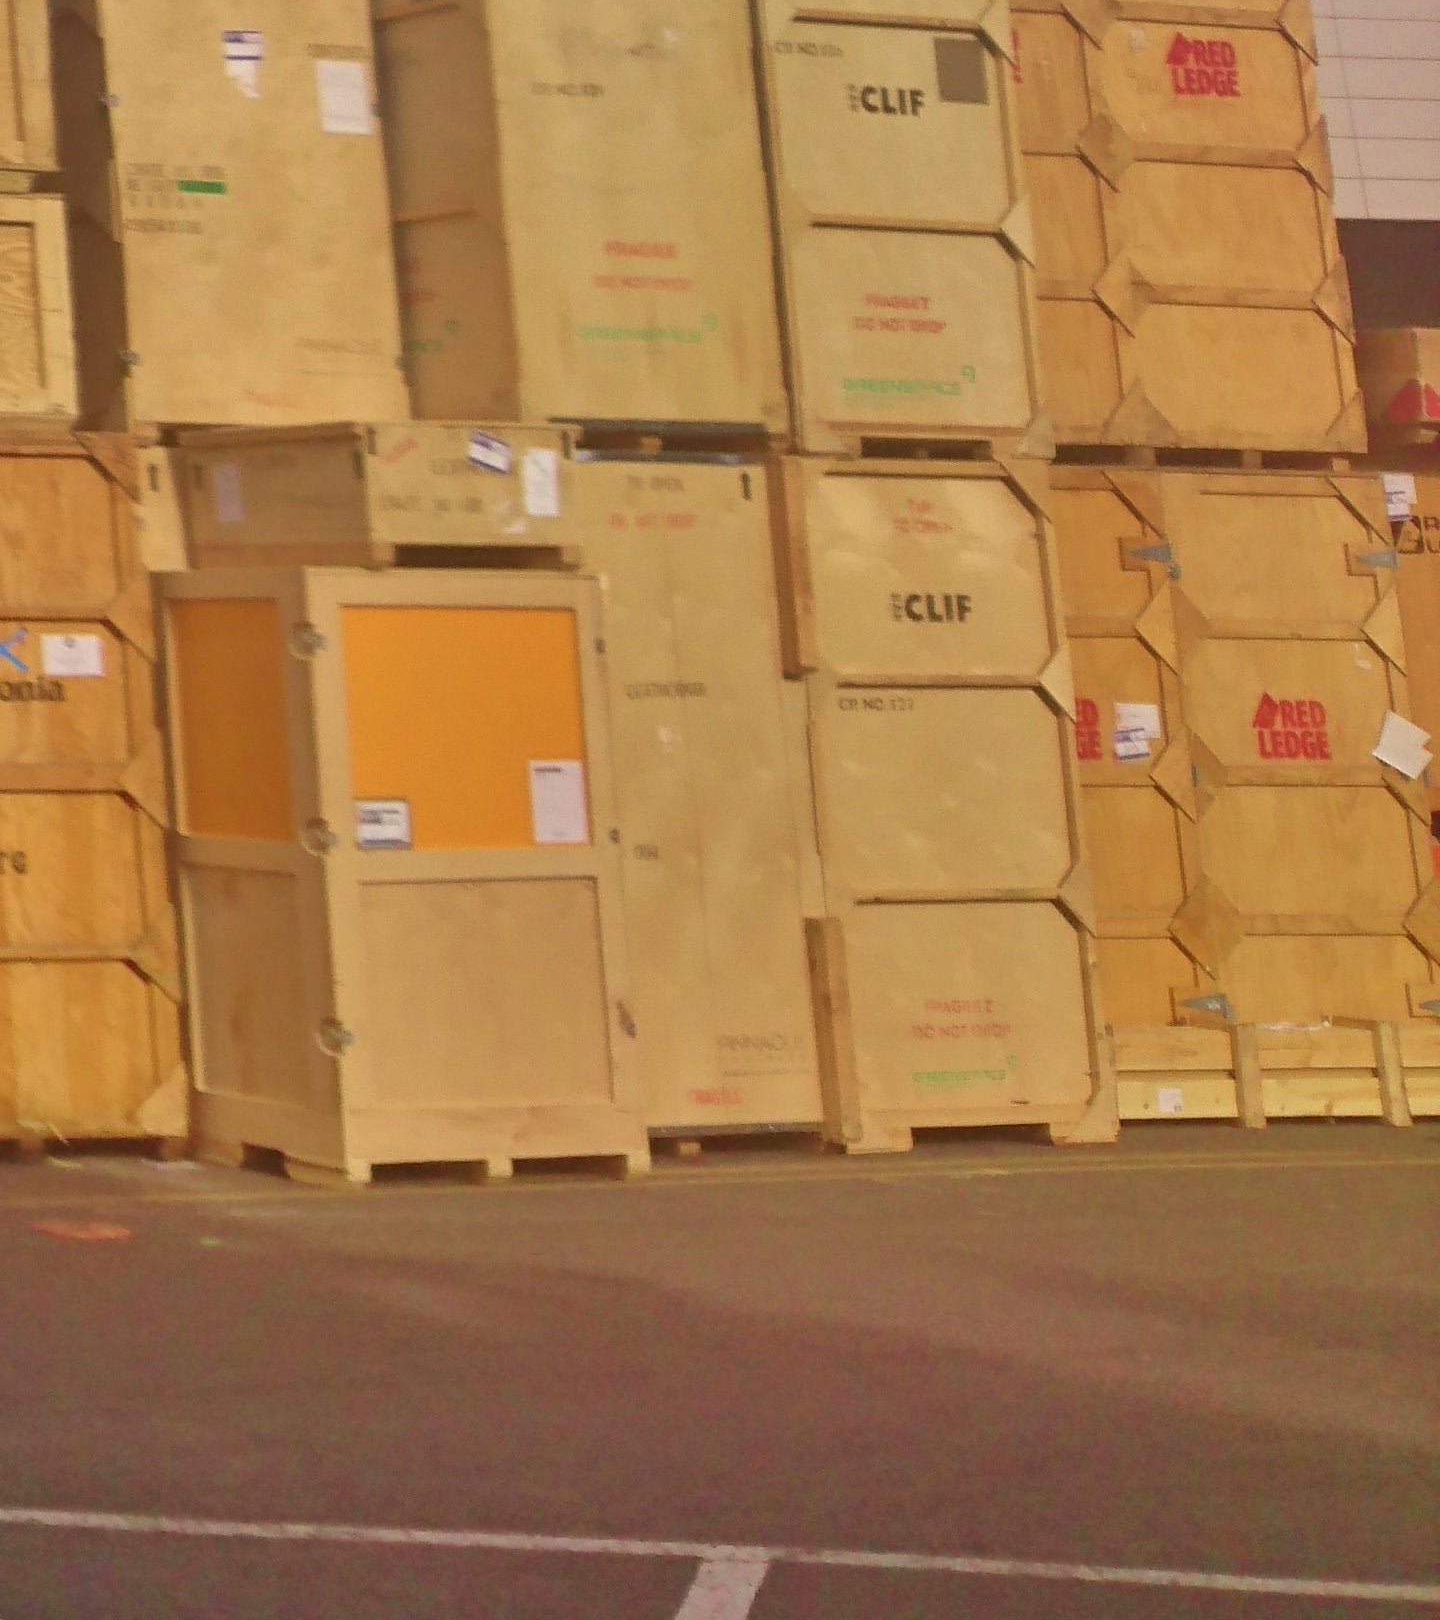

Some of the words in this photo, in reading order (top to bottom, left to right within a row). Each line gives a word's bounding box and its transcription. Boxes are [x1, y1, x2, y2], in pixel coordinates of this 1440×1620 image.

[1192, 39, 1237, 68] RED
[1171, 69, 1242, 98] LEDGE
[860, 86, 926, 118] CLIF
[904, 592, 973, 623] CLIF
[1280, 699, 1327, 730] RED
[1257, 729, 1333, 761] LEDGE
